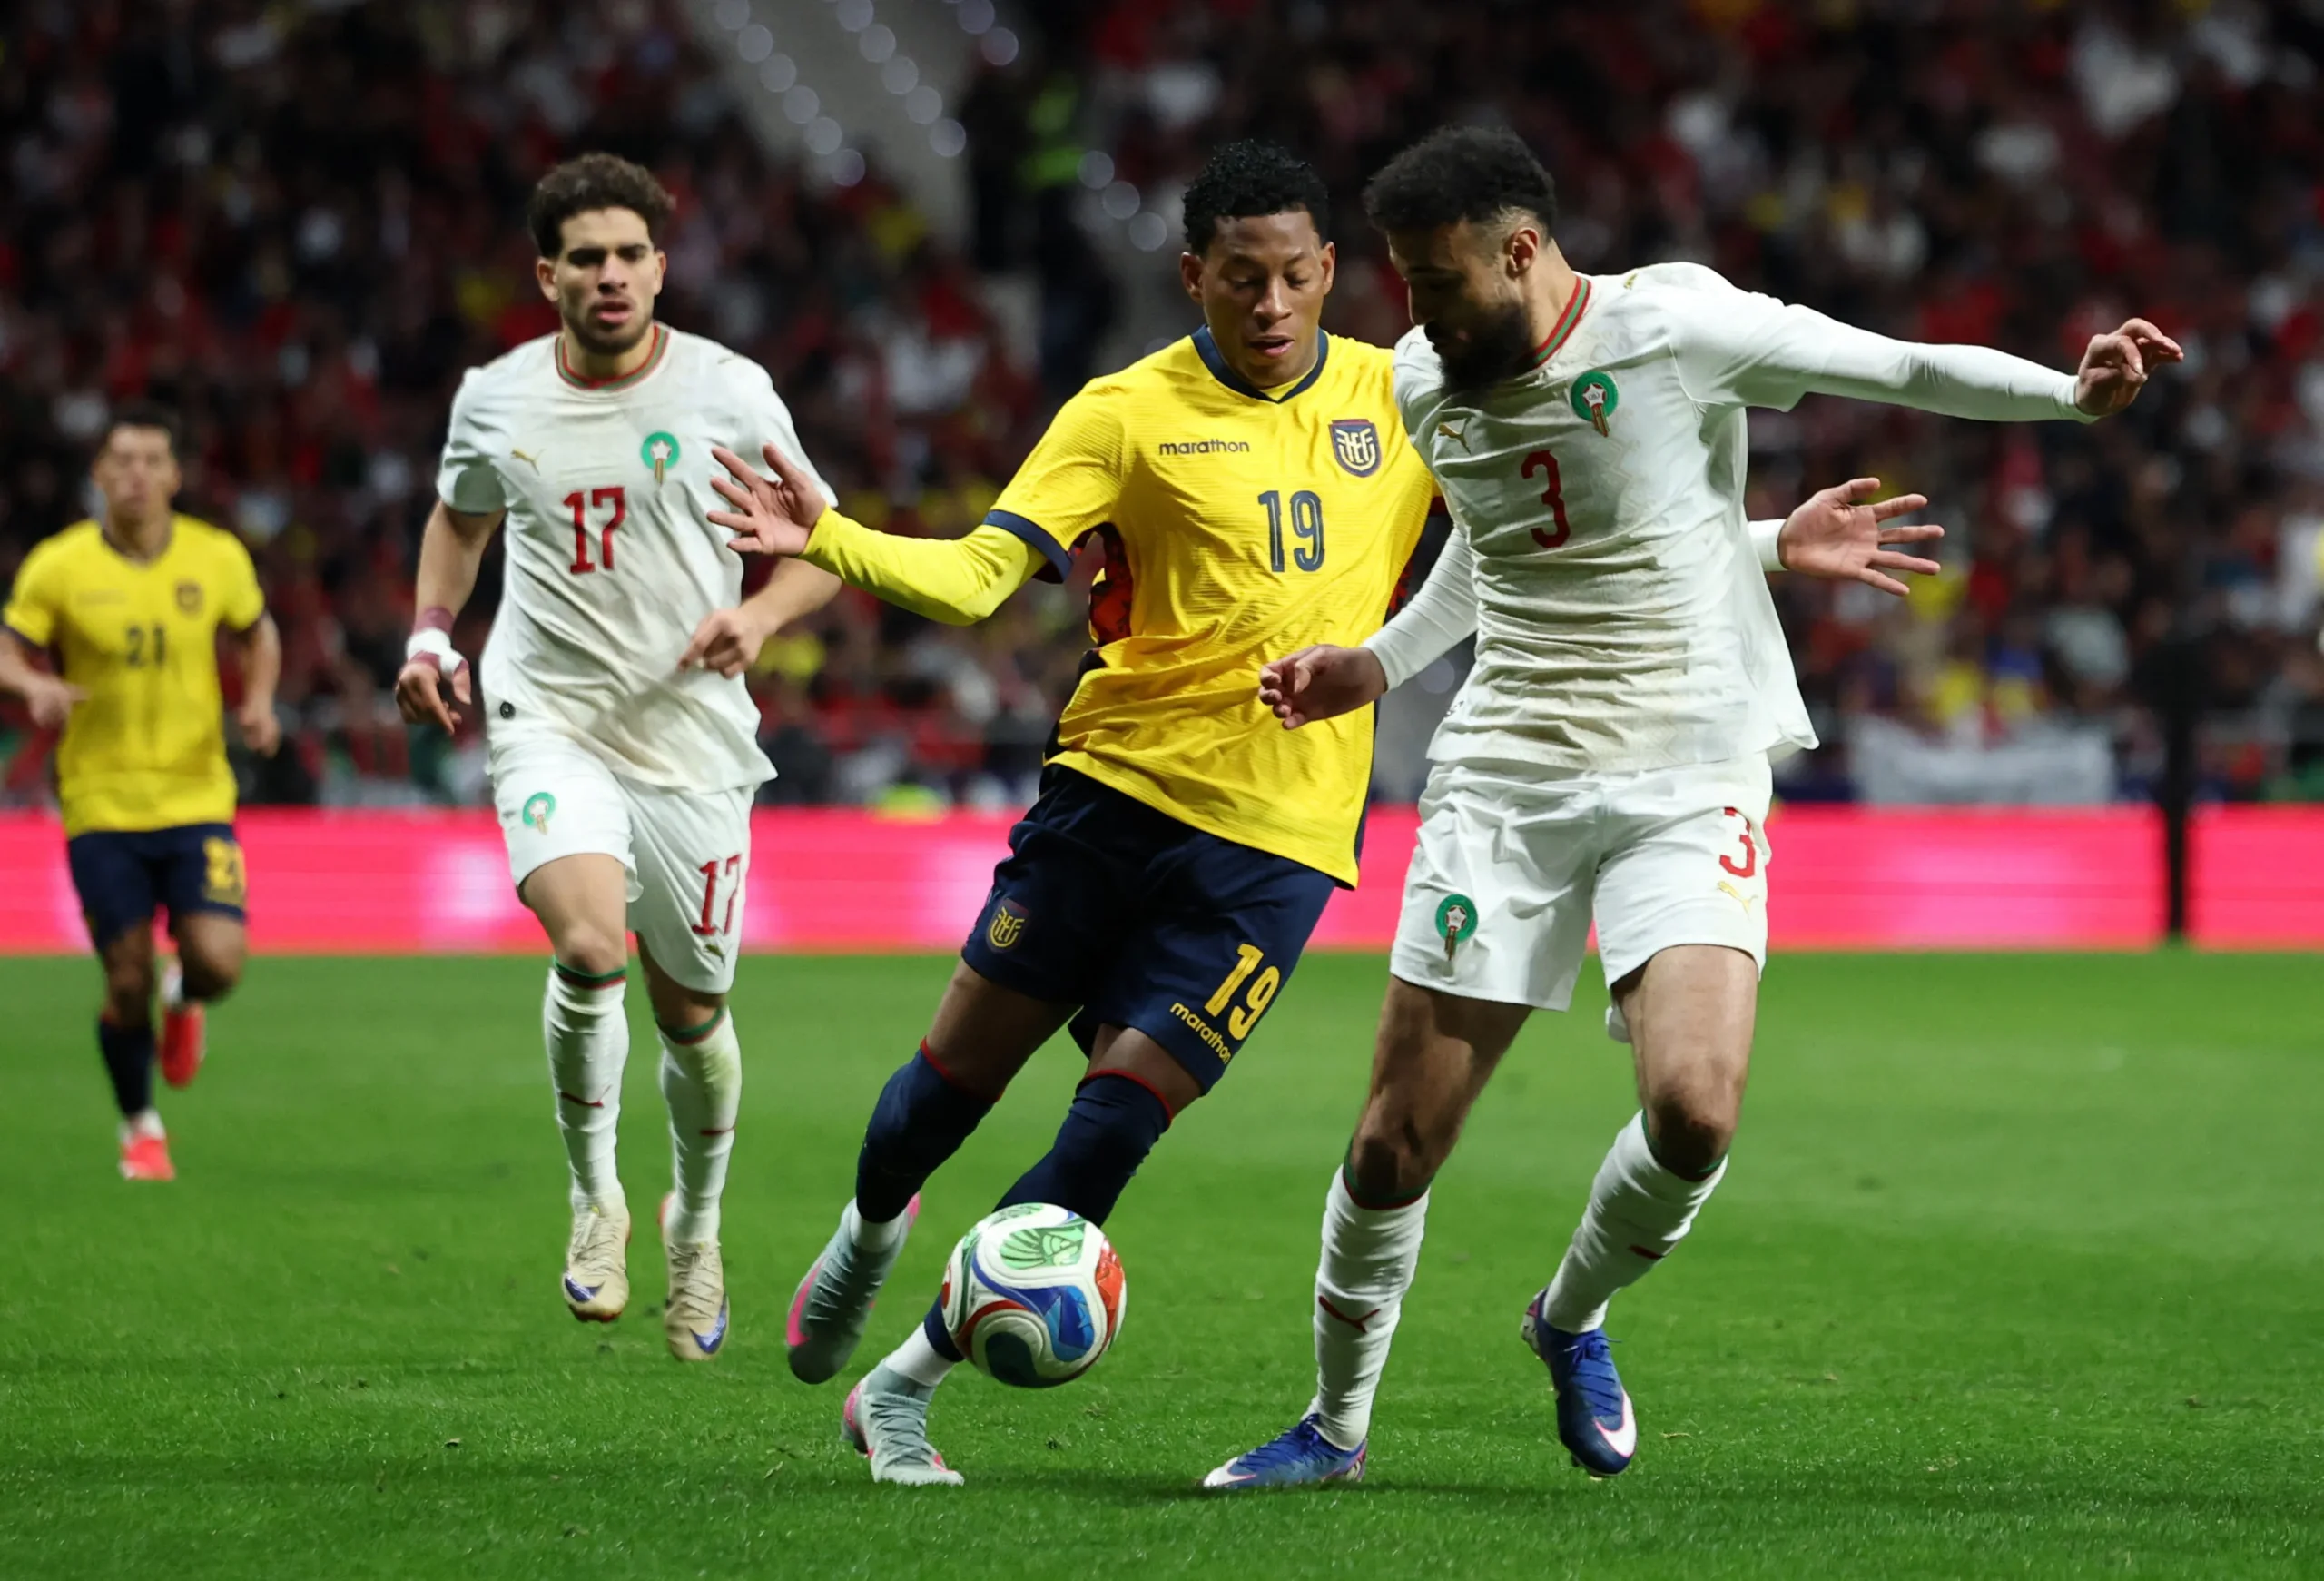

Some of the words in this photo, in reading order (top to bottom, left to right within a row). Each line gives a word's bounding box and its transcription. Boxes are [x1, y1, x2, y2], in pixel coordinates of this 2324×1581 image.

[1159, 439, 1250, 455] marathon
[563, 487, 626, 574] 17
[1258, 489, 1325, 573] 19
[1521, 450, 1571, 548] 3
[125, 621, 166, 668] 21
[1719, 806, 1756, 878] 3
[692, 854, 742, 935] 17
[1204, 943, 1280, 1041] 19
